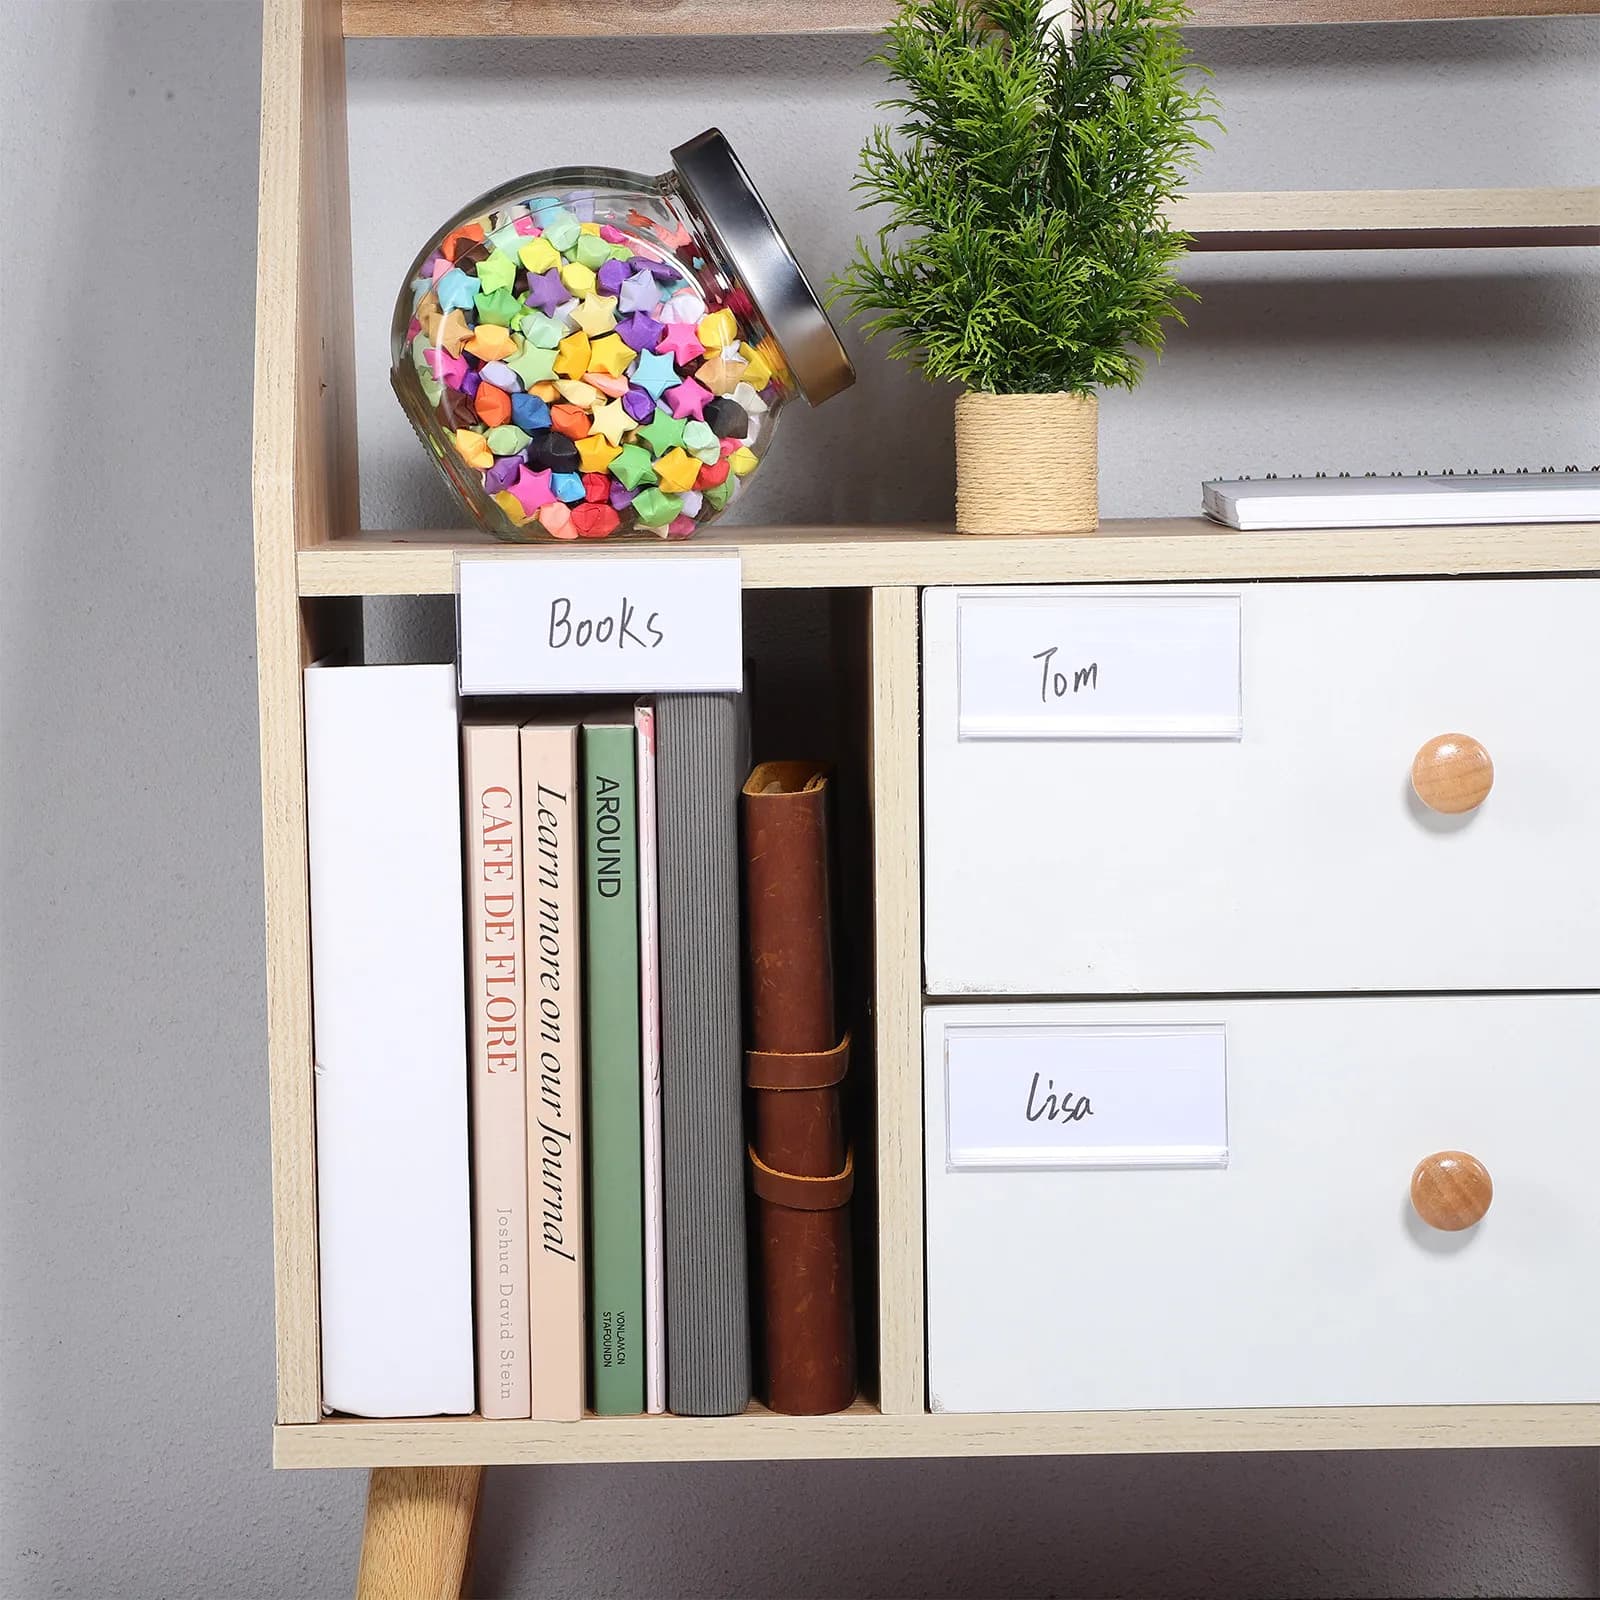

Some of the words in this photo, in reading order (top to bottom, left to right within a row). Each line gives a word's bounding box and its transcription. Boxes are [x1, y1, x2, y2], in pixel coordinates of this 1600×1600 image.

[549, 596, 664, 649] Books
[1032, 646, 1098, 703] Tom
[480, 786, 513, 883] CAFE
[536, 780, 568, 890] Learn
[595, 775, 622, 899] AROUND
[484, 891, 516, 943] DE
[538, 897, 562, 991] more
[484, 952, 518, 1074] FLORE
[540, 998, 562, 1044] on
[541, 1052, 562, 1118] our
[1026, 1072, 1094, 1124] Lisa
[536, 1115, 577, 1262] Journal
[496, 1207, 513, 1275] Joshua
[498, 1283, 514, 1340] David
[499, 1349, 515, 1400] Stein
